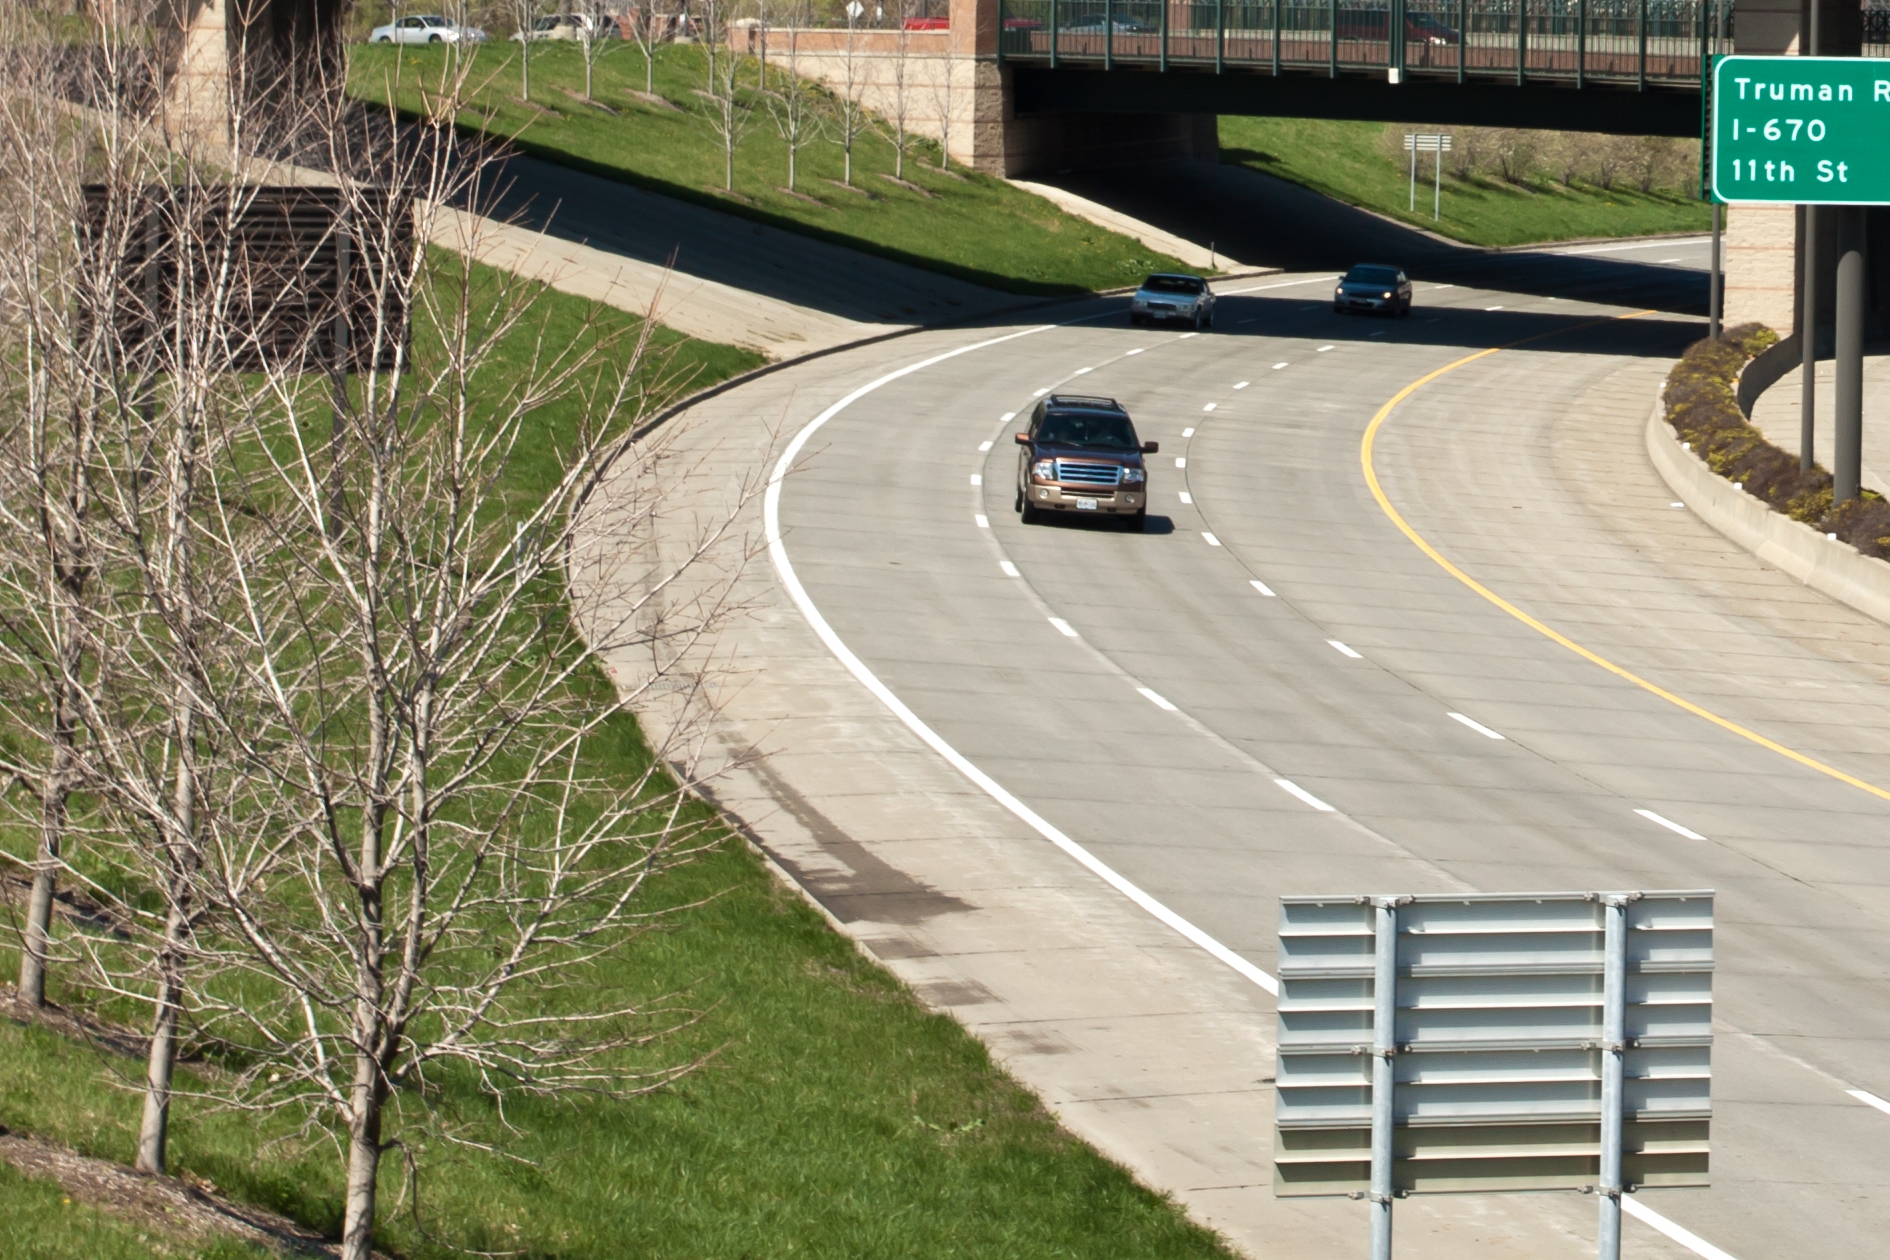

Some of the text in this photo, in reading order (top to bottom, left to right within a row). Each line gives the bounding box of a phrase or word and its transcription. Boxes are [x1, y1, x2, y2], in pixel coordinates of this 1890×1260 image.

[1735, 78, 1852, 101] Truman
[1734, 119, 1825, 141] I-670
[1733, 159, 1794, 181] 11th
[1817, 160, 1847, 182] St
